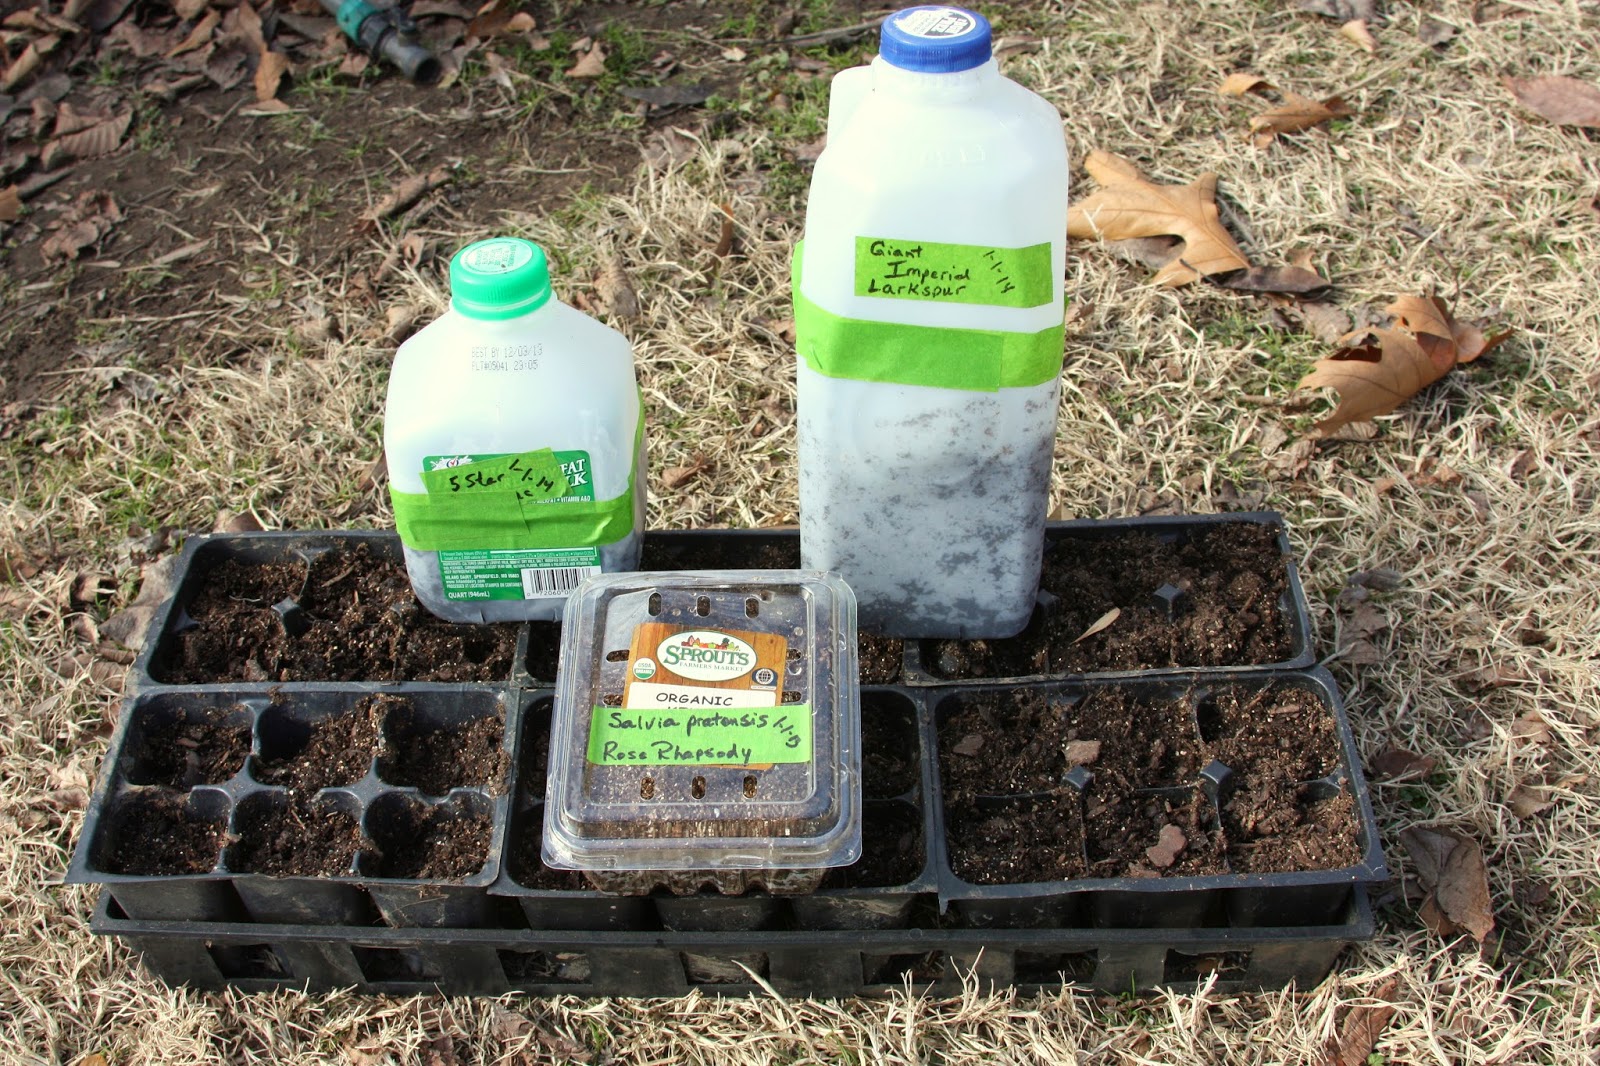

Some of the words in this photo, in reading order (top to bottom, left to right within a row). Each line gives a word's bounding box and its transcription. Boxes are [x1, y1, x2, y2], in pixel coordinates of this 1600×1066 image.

[870, 240, 923, 258] Giant
[868, 278, 966, 298] Larkspur
[472, 346, 487, 358] BEST
[491, 347, 499, 358] BY
[465, 471, 505, 488] Star
[663, 645, 750, 666] SPROUTS
[656, 692, 733, 706] ORGANIC
[608, 712, 680, 730] Salvia
[603, 740, 648, 761] Rose
[651, 740, 751, 767] Rhapsody
